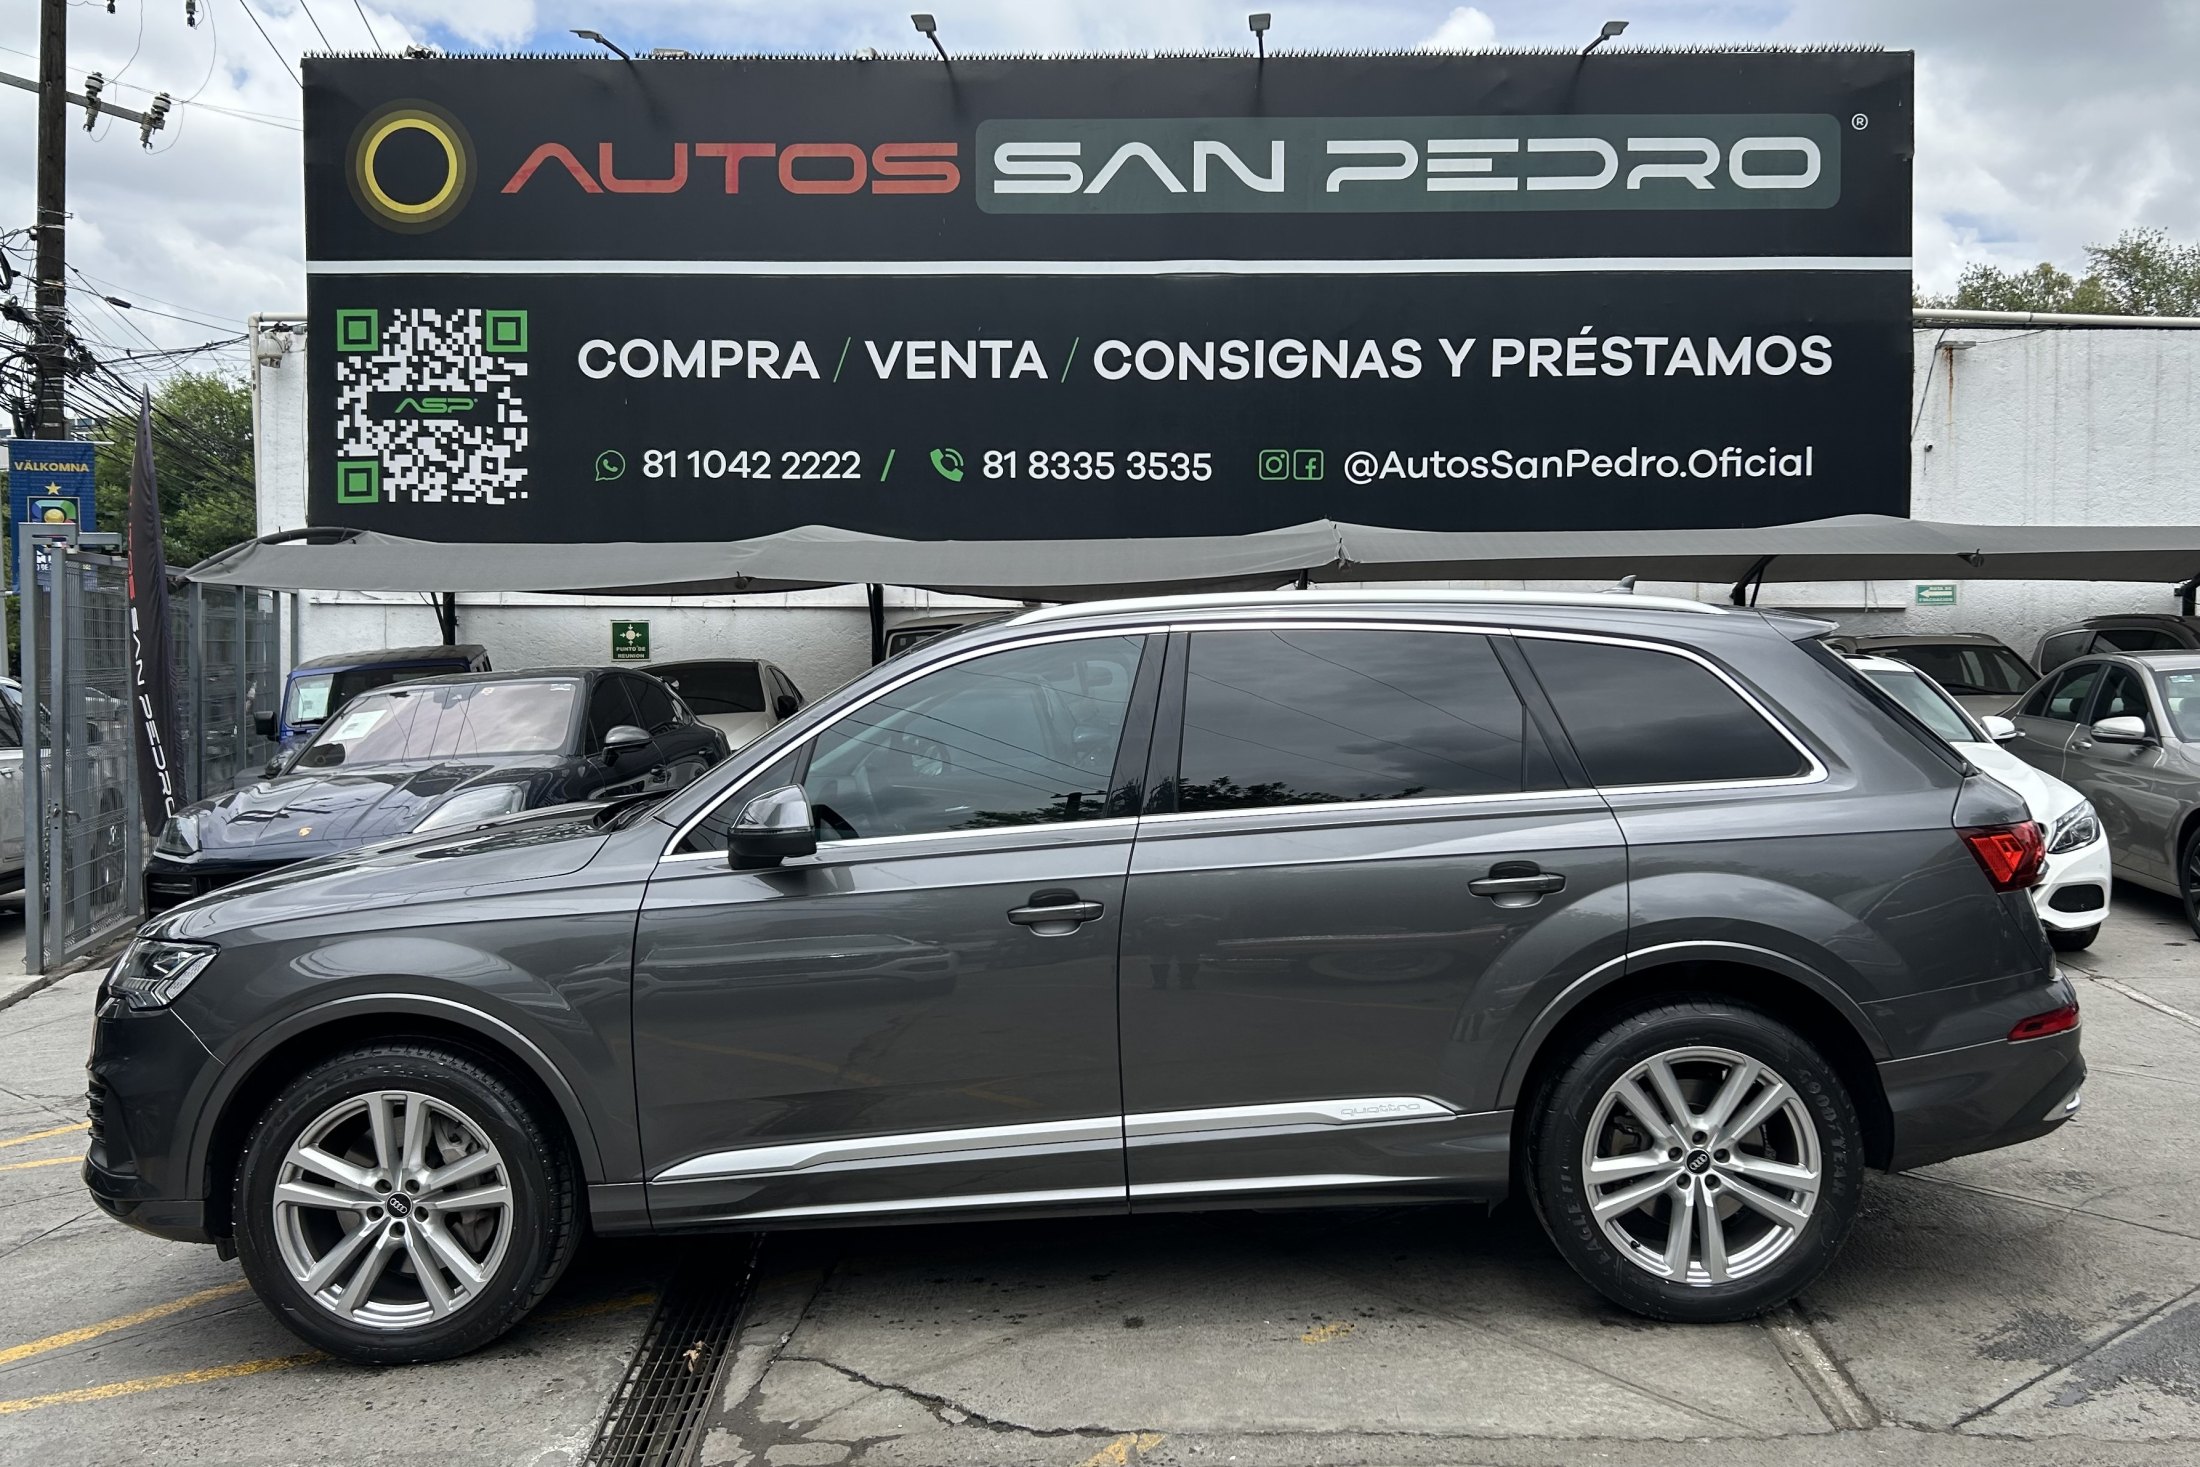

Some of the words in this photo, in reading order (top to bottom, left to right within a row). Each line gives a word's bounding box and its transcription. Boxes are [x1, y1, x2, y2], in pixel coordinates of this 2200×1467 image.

[501, 142, 961, 195] AUTOS
[993, 140, 1285, 194] SAN
[1326, 136, 1821, 193] PEDRO
[577, 338, 821, 380] COMPRA
[864, 338, 1049, 380] VENTA
[1093, 338, 1423, 381] CONSIGNAS
[1438, 338, 1477, 378] Y
[1491, 325, 1833, 378] PRÉSTAMOS
[14, 460, 90, 473] VÄLKOMNA
[642, 449, 677, 479] 81
[687, 449, 772, 480] 1042
[781, 450, 861, 480] 2222
[982, 450, 1016, 479] 81
[1028, 450, 1115, 481] 8335
[1126, 450, 1213, 482] 3535
[1344, 446, 1813, 485] @AutosSanPedro.Oficial
[1340, 1103, 1421, 1117] quattro
